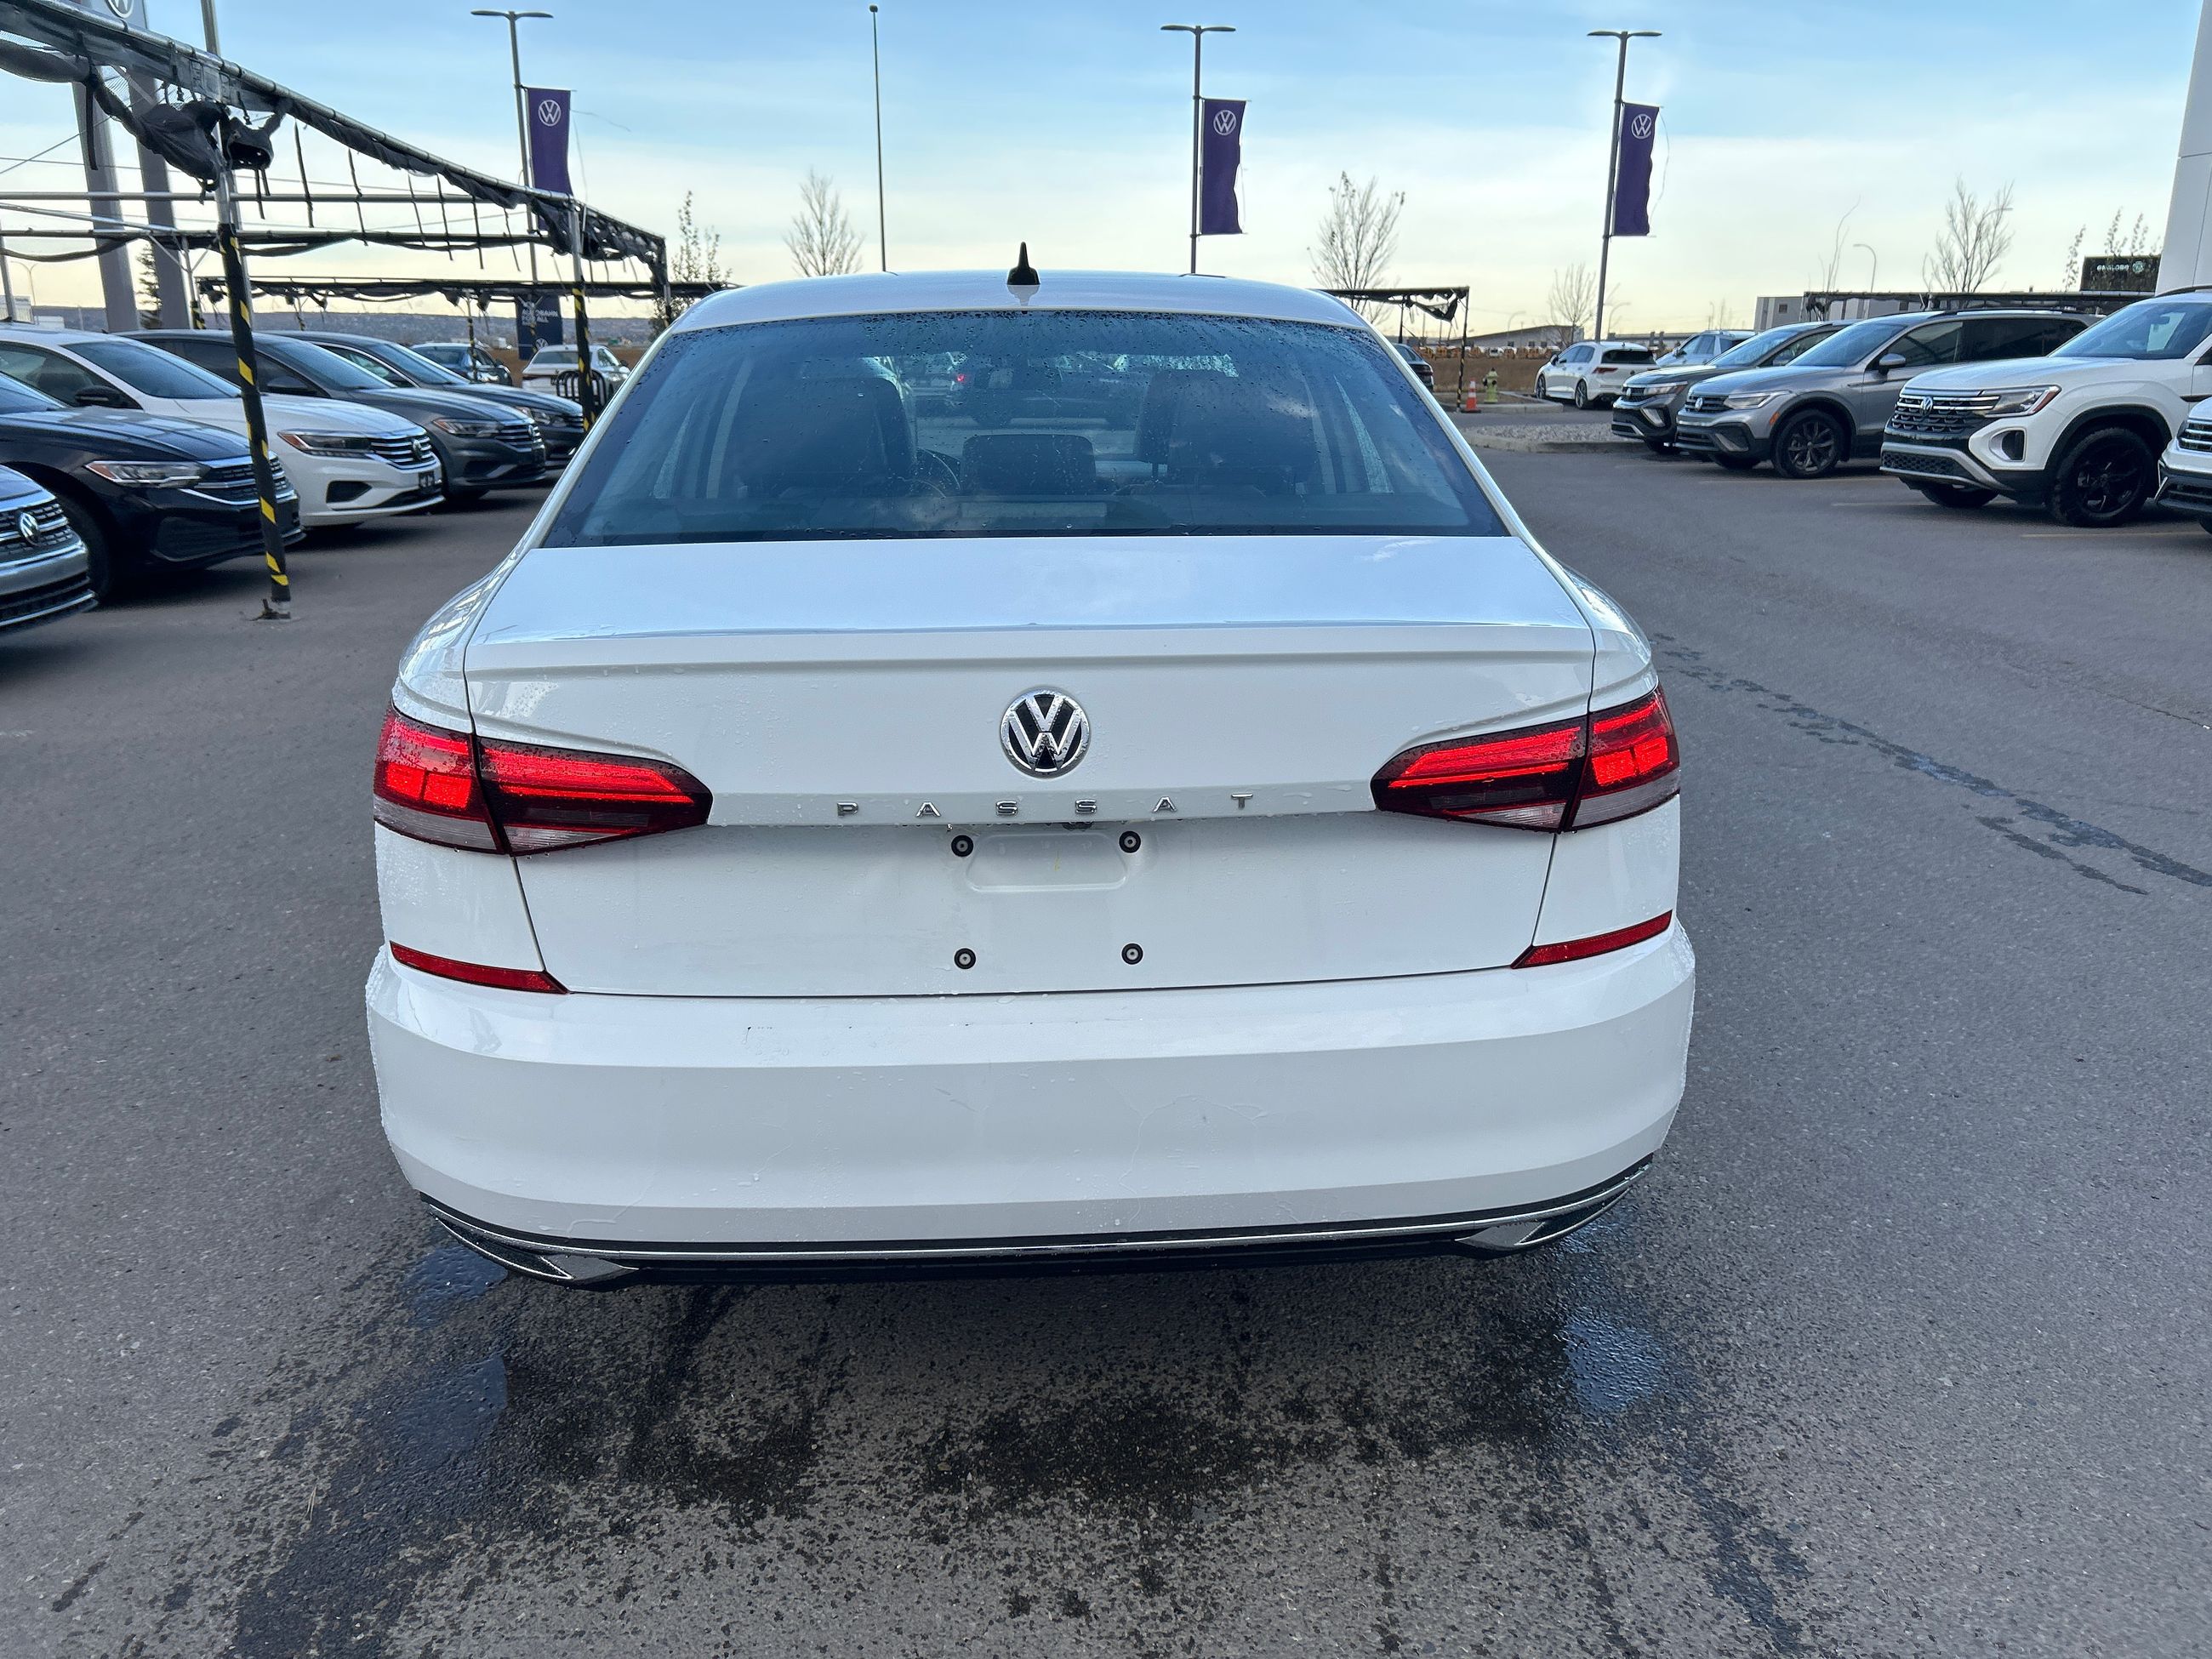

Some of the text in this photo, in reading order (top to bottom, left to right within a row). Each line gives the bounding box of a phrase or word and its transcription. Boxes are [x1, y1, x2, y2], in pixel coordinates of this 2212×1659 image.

[539, 100, 561, 126] VW
[1213, 110, 1236, 135] VW
[1632, 114, 1651, 139] VW
[1001, 687, 1090, 778] VW
[836, 792, 1254, 818] PASSAT
